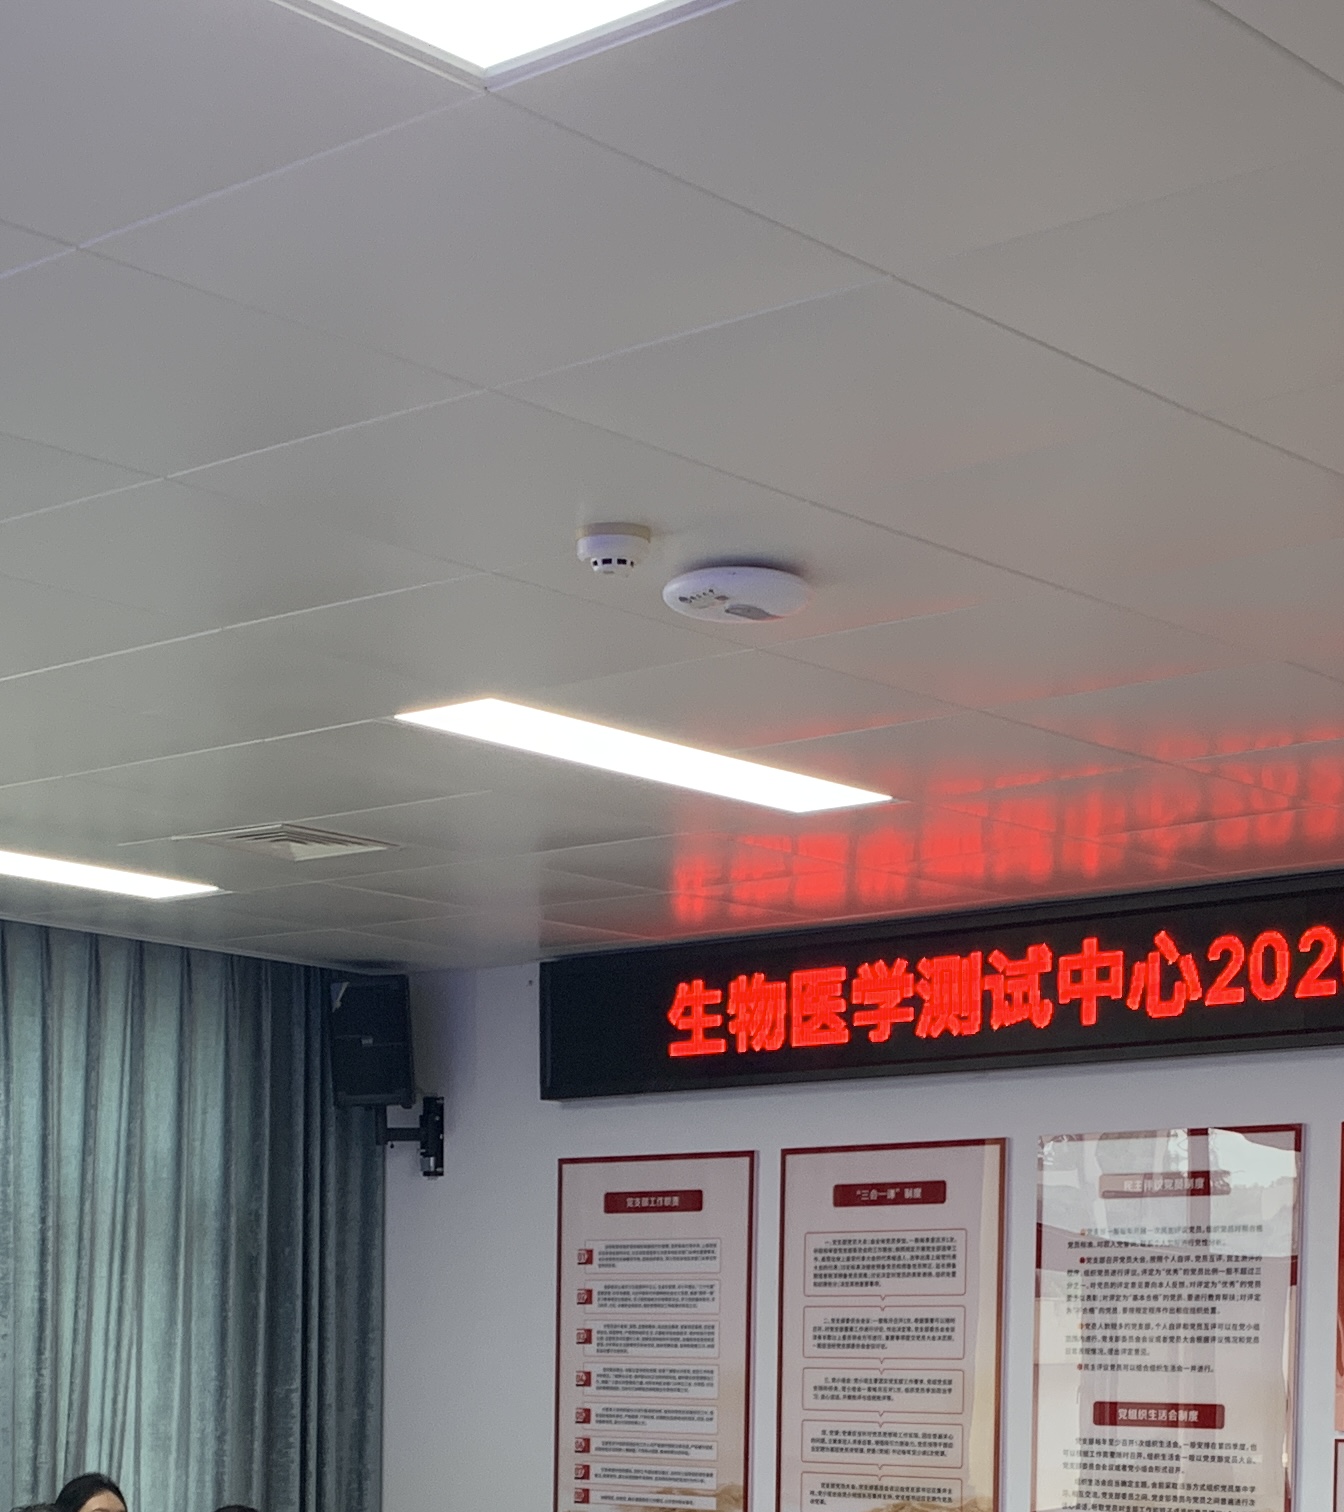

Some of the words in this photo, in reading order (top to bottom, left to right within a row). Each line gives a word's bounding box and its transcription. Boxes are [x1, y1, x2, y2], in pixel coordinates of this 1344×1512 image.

[1117, 1408, 1200, 1423] 党组织生活会制度
